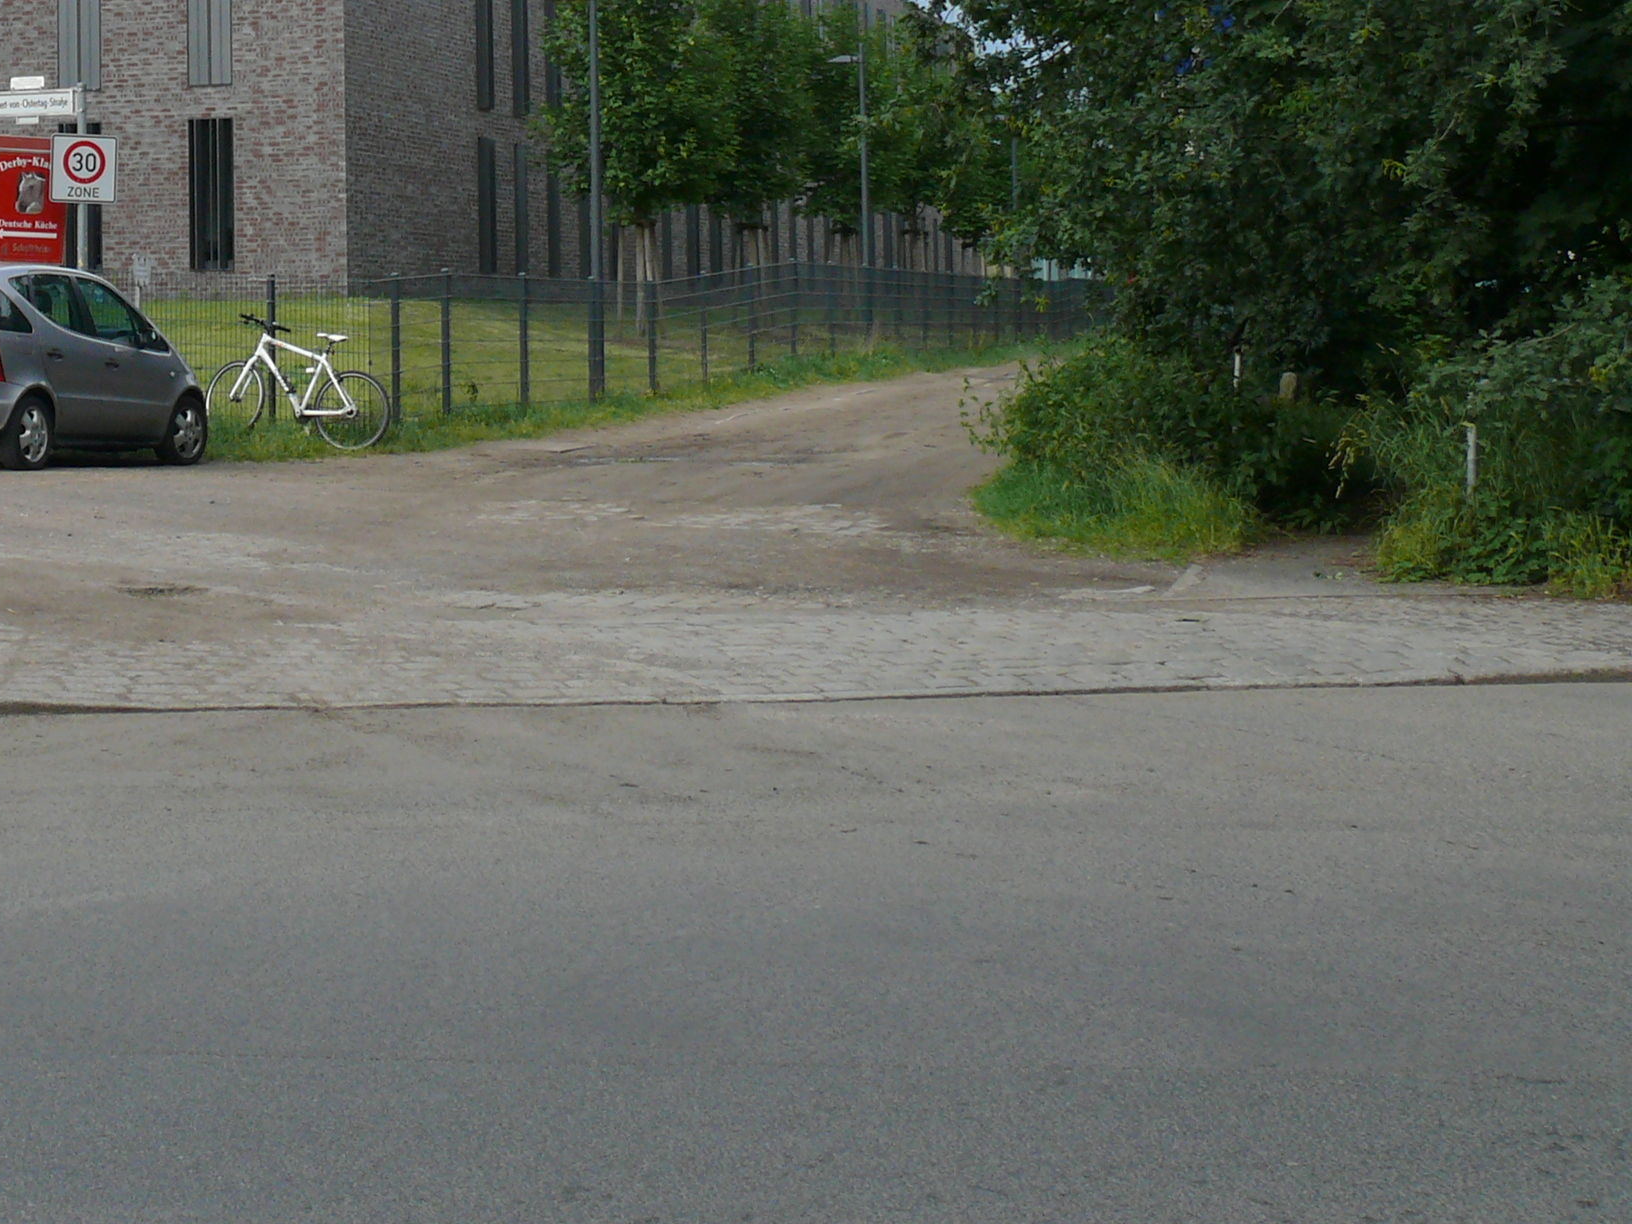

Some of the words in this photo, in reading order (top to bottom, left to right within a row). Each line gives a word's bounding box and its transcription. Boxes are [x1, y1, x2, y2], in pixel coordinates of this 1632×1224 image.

[72, 152, 97, 173] 30
[67, 186, 100, 198] ZONE
[34, 220, 58, 229] Küche
